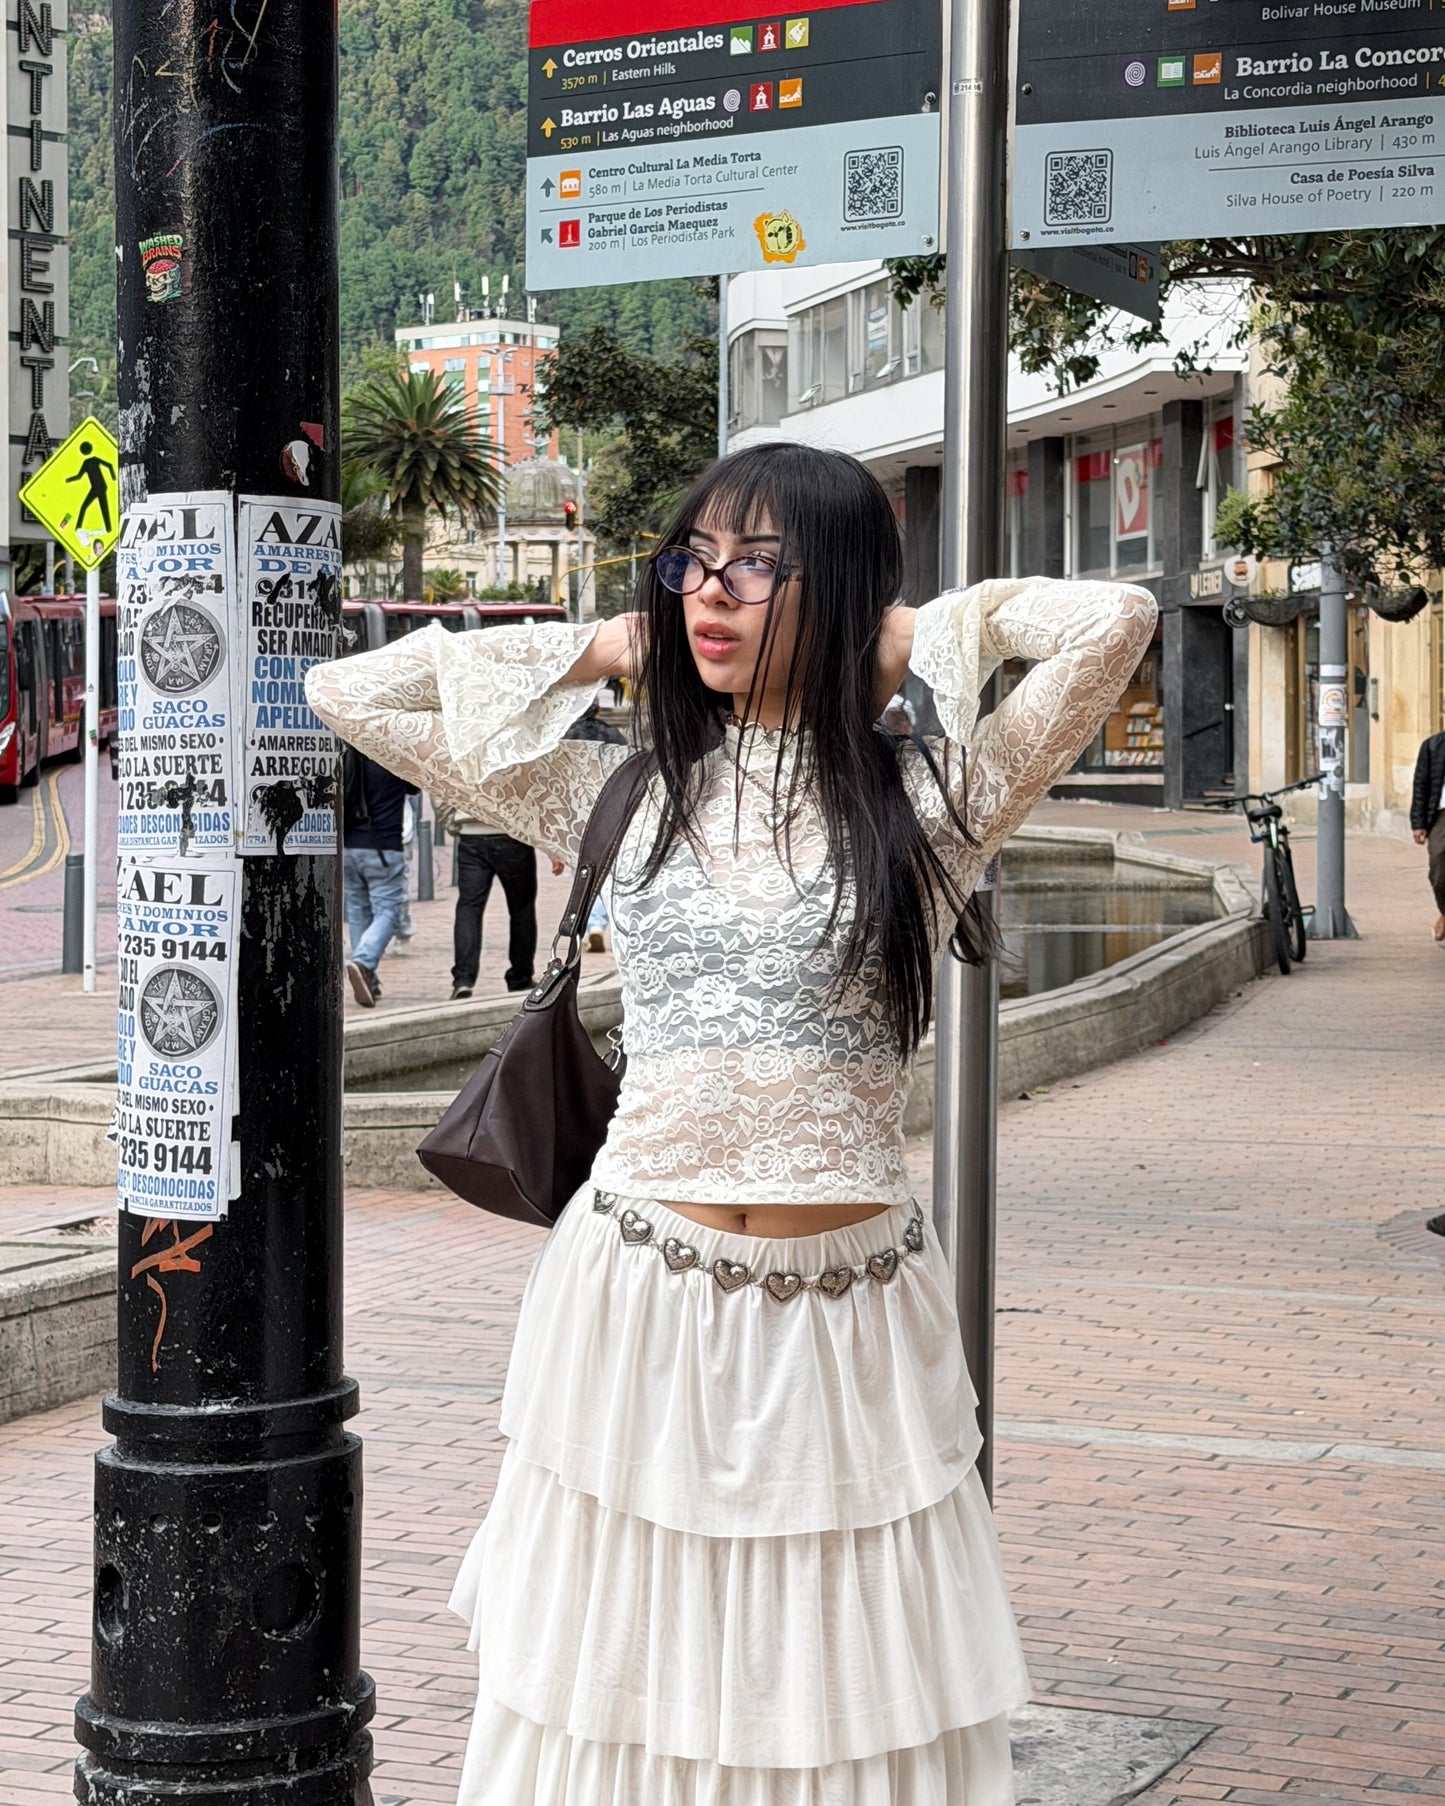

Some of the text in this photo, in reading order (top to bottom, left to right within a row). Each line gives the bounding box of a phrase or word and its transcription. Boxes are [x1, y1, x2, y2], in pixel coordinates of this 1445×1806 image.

[1262, 0, 1421, 20] Bolivar House Museum
[563, 31, 724, 67] Cerros Orientales
[1236, 45, 1445, 77] Barrio La Concor
[561, 63, 676, 90] 3570 m Eastern Hills
[1224, 88, 1239, 100] La
[1243, 81, 1312, 99] Concordia
[1316, 73, 1418, 95] neighborhood
[561, 96, 716, 127] Barrio Las Aguas
[560, 116, 734, 150] 530 m Las Aguas neighborhood
[1225, 114, 1434, 139] Biblioteca Luis Ángel Arango
[1195, 134, 1435, 159] Luis Ángel Arango Library 430 m
[588, 151, 762, 179] Centro Cultural La Media Torta
[1290, 164, 1435, 185] Casa de Poesía Silva
[589, 164, 799, 198] 580 m La Media Torta Cultural Center
[1226, 186, 1433, 207] Silva House of Poetry 220 m
[588, 201, 728, 225] Parque de Los Periodistas
[588, 226, 627, 239] Gabriel
[840, 219, 906, 231] www.visitbogota.co
[1040, 225, 1114, 236] www.visitbogota.co
[139, 235, 183, 255] WASHED
[589, 226, 735, 251] 200 m Los Periodistas Park
[17, 0, 54, 522] NTINENTA
[142, 246, 182, 267] BRAINS
[254, 545, 329, 561] AMARRES
[257, 559, 312, 574] DE
[257, 629, 333, 658] SER AMADO
[254, 656, 296, 680] CON
[153, 700, 208, 714] SACO
[143, 714, 226, 729] GUACAS
[125, 737, 138, 751] DEL
[140, 734, 177, 751] MISMO
[180, 733, 216, 749] SEXO
[258, 735, 316, 751] AMARRES
[319, 736, 333, 752] DEL
[134, 757, 150, 777] LA
[153, 754, 223, 776] SUERTE
[251, 756, 326, 777] ARREGLO
[141, 812, 230, 833] DESCONCIDAS
[134, 904, 141, 916] Y
[143, 905, 228, 922] DOMINIOS
[123, 917, 220, 938] AMOR
[124, 934, 156, 958] 235
[162, 939, 227, 962] 9144
[184, 980, 202, 998] TRA
[149, 1062, 203, 1080] SACO
[138, 1075, 219, 1095] GUACAS
[122, 1090, 206, 1116] DEL MISMO SEXO
[129, 1113, 142, 1136] LA
[145, 1117, 211, 1142] SUERTE
[154, 1143, 212, 1175] 9144
[132, 1173, 215, 1200] DESCONOCIDAS
[149, 1198, 212, 1212] GARANTIZADOS
